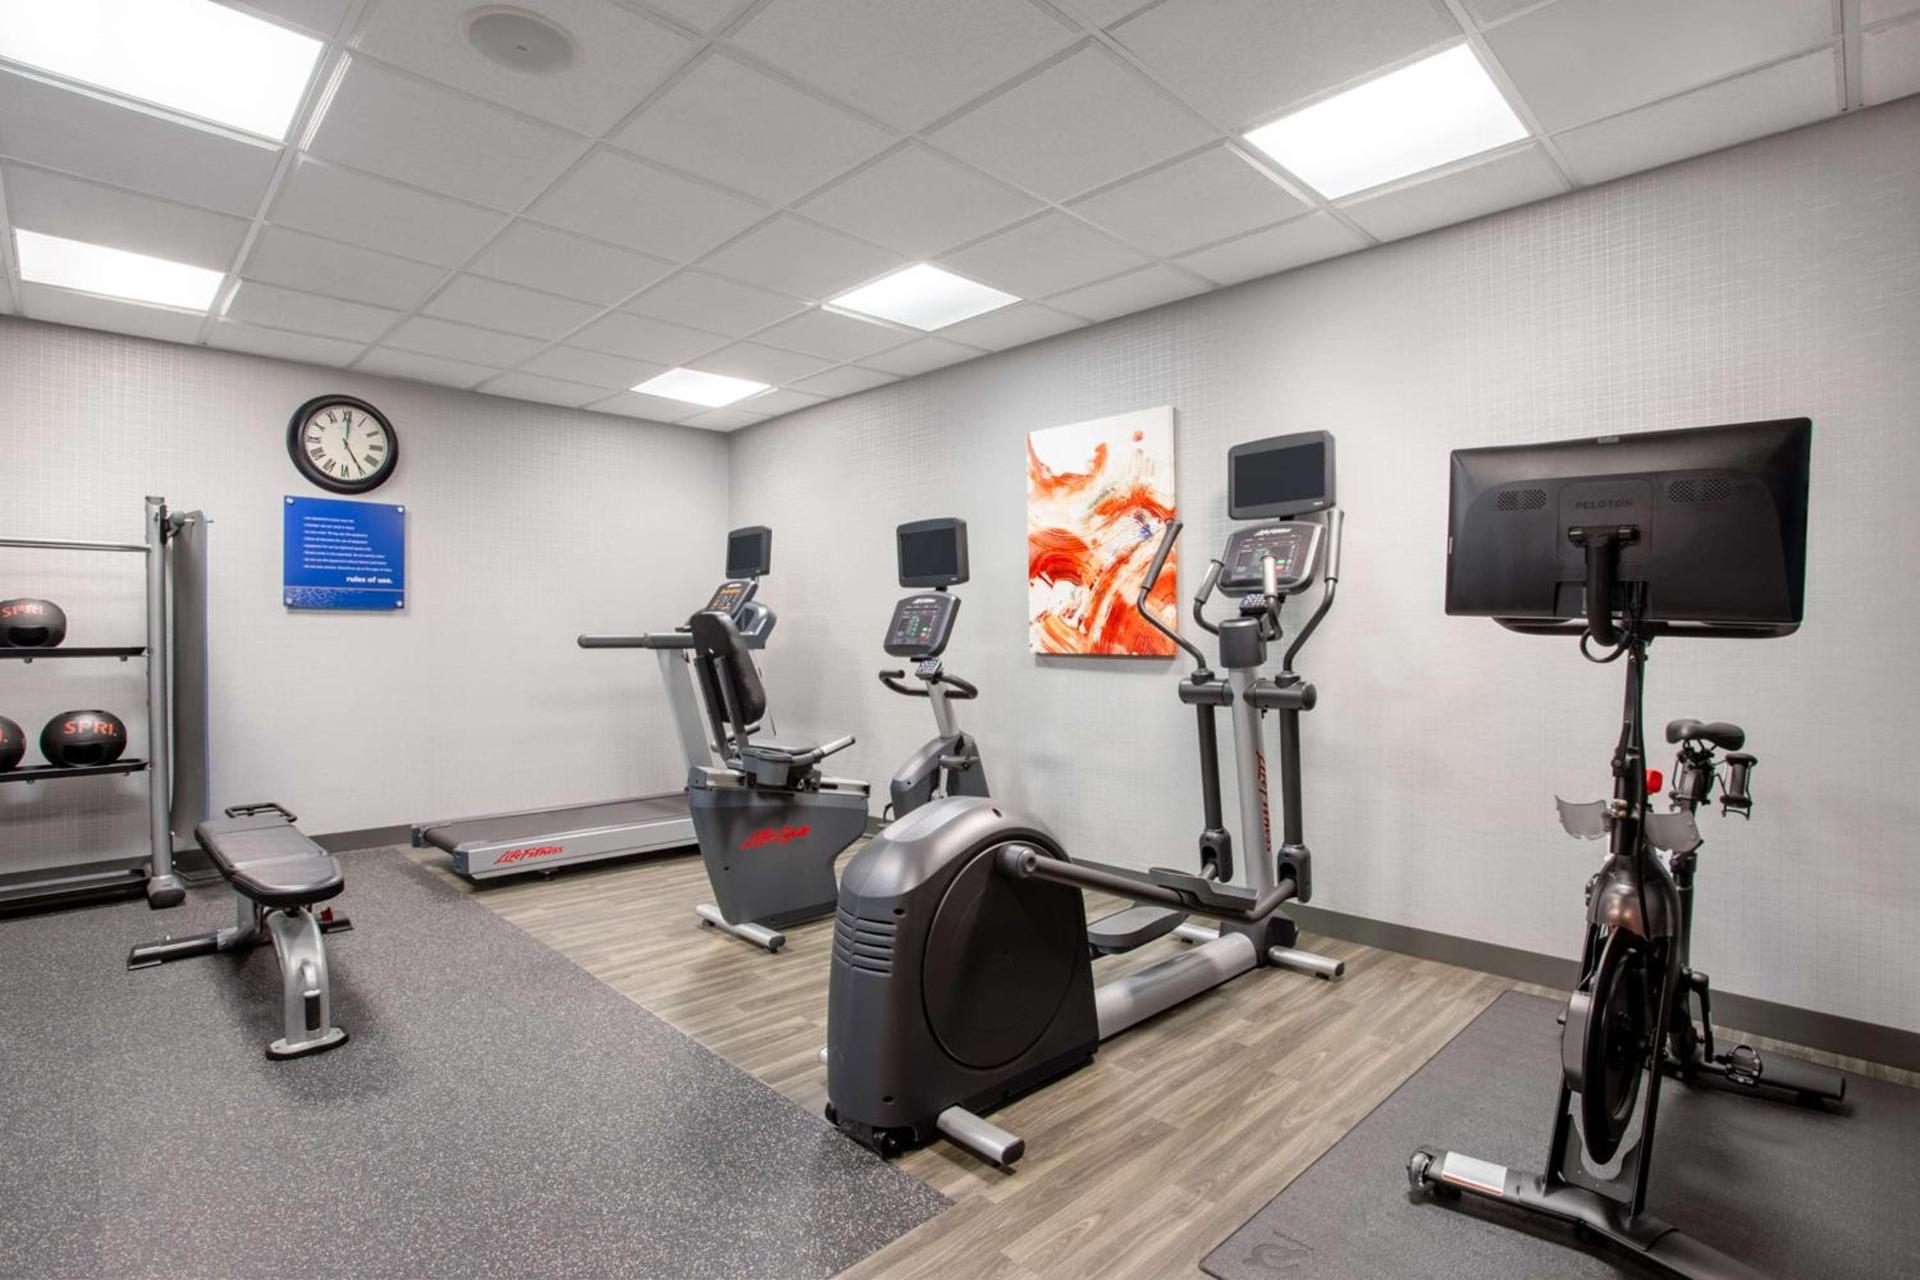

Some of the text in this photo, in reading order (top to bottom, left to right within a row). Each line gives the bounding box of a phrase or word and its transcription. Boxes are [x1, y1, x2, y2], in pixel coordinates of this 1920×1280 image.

[1575, 499, 1634, 510] PELOTON
[367, 576, 377, 584] of
[1, 604, 44, 618] SPRI
[63, 720, 115, 735] SPRI
